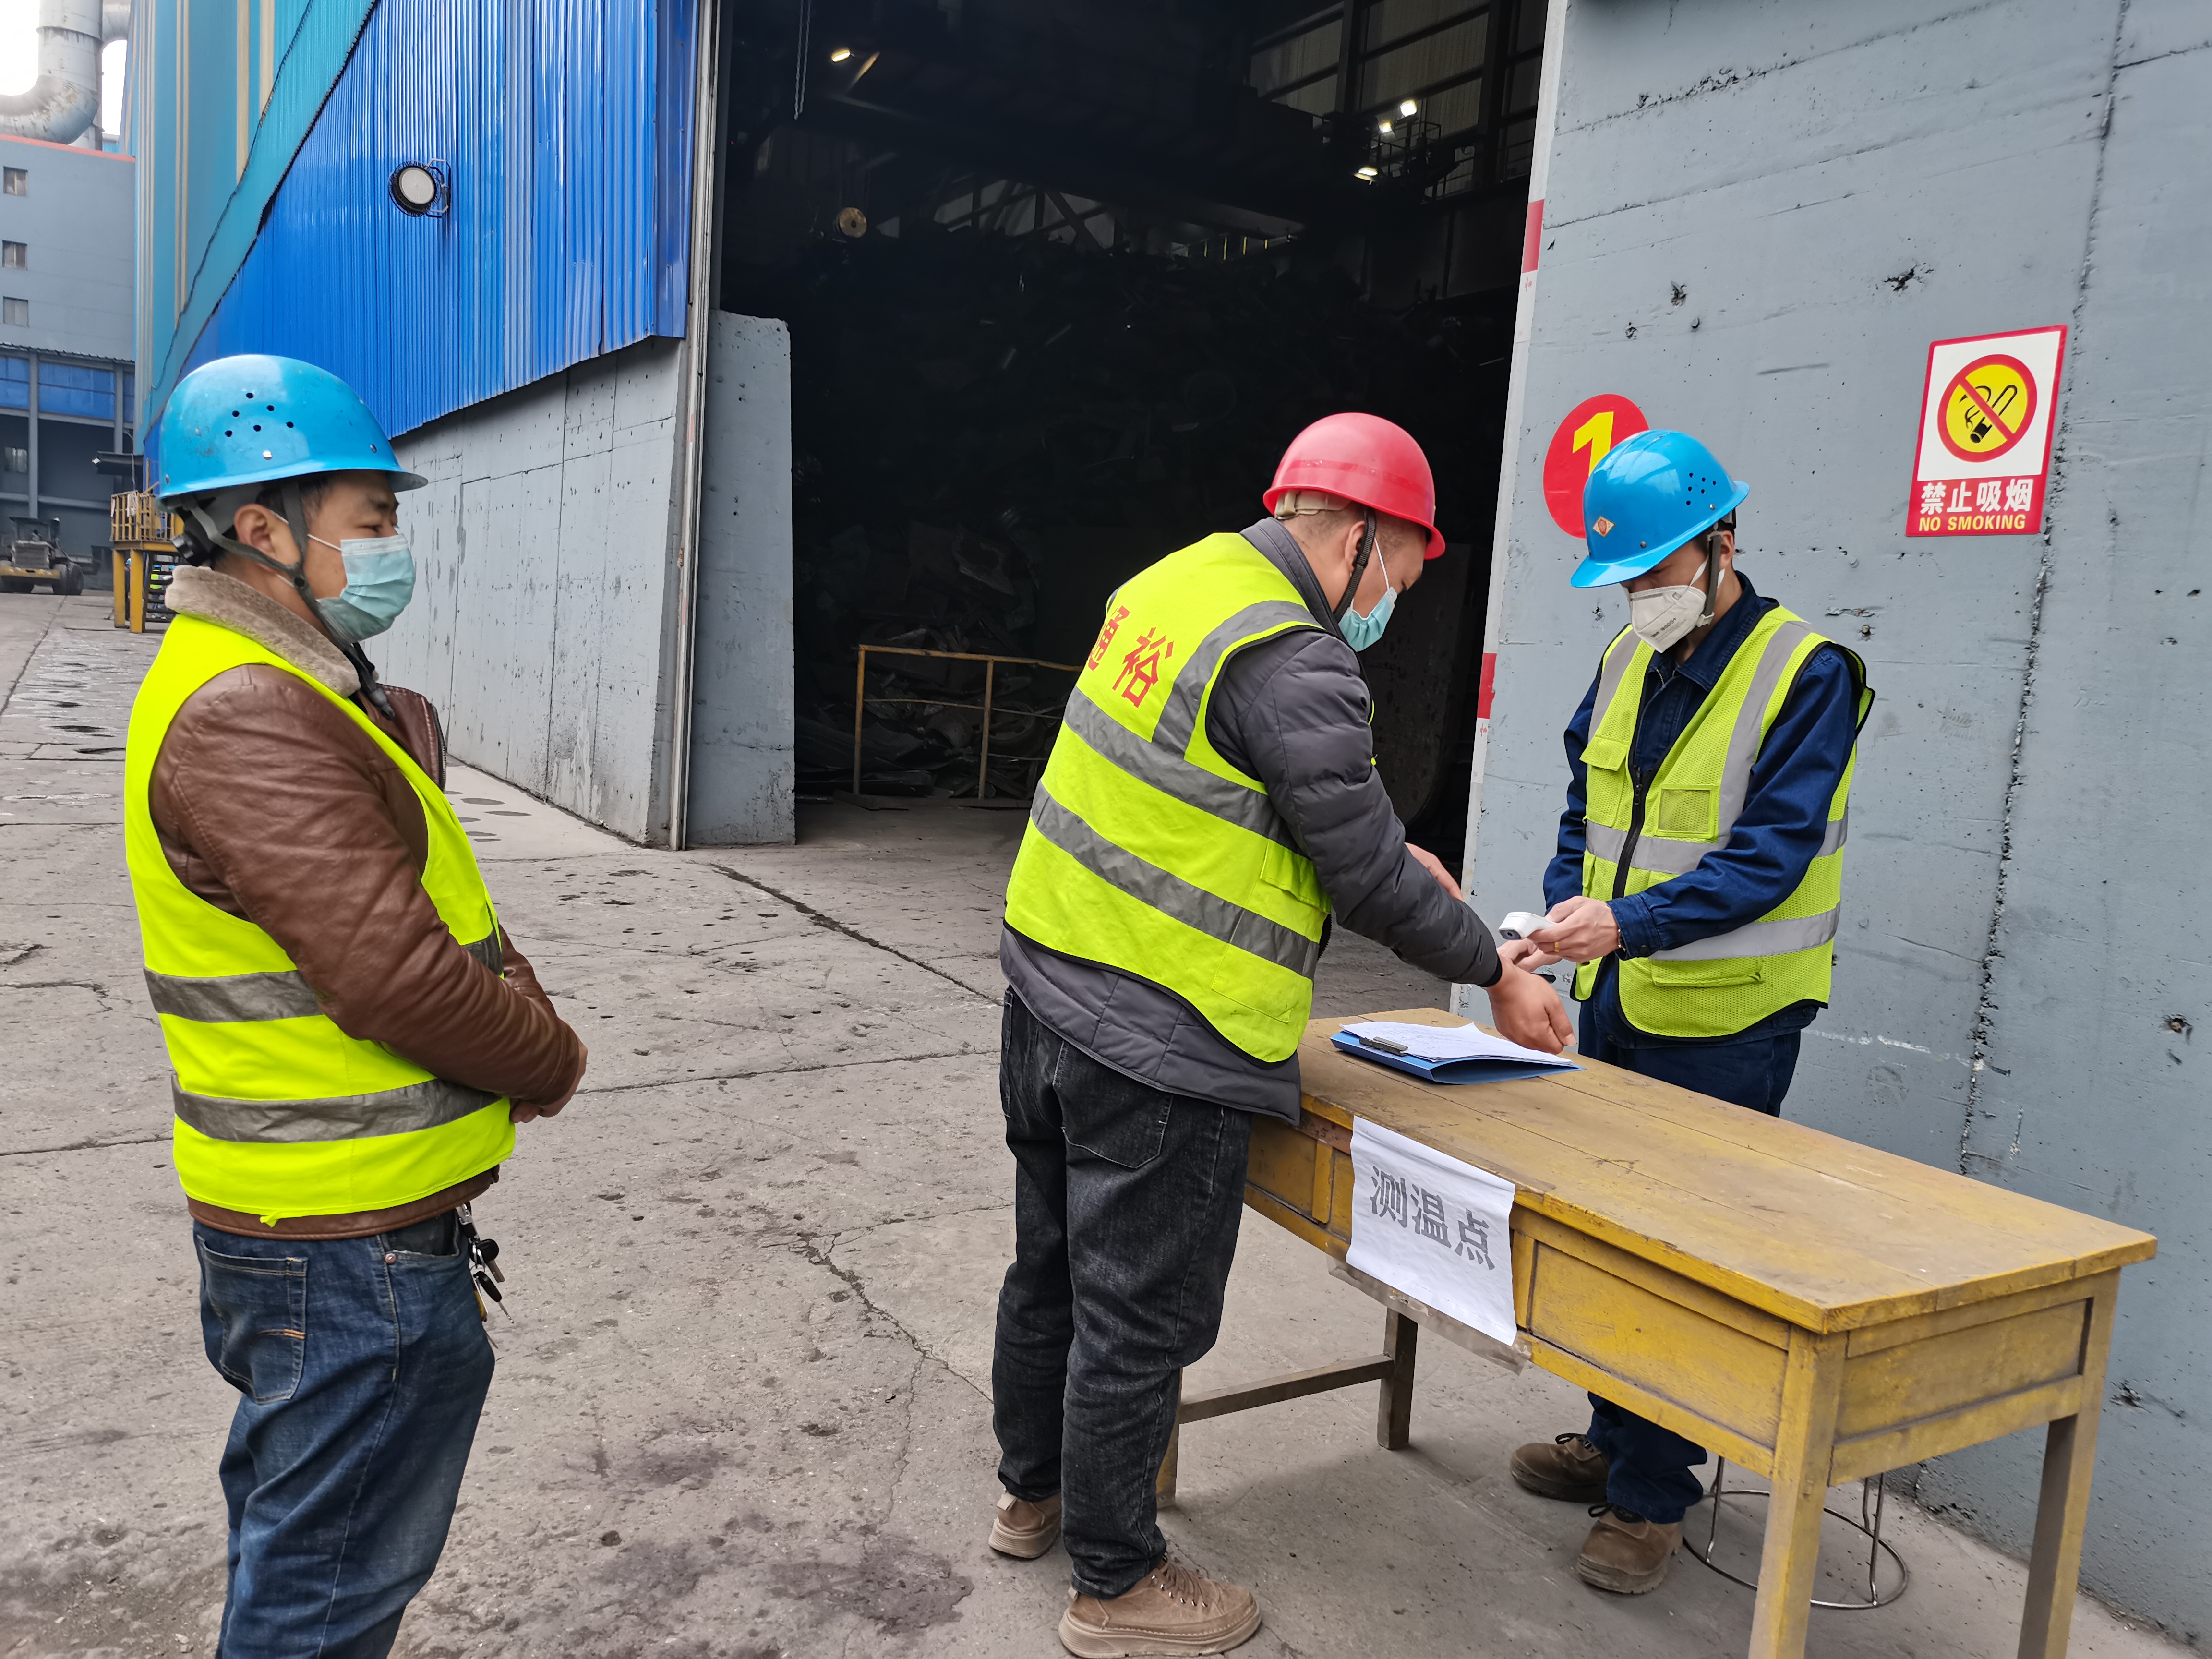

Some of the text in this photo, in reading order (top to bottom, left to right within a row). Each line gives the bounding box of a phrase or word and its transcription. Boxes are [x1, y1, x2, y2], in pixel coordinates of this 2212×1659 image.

[1572, 411, 1614, 477] 1
[1920, 479, 2033, 515] 禁止吸烟
[1919, 514, 2026, 532] NO SMOKING
[1370, 1166, 1495, 1270] 测温点
